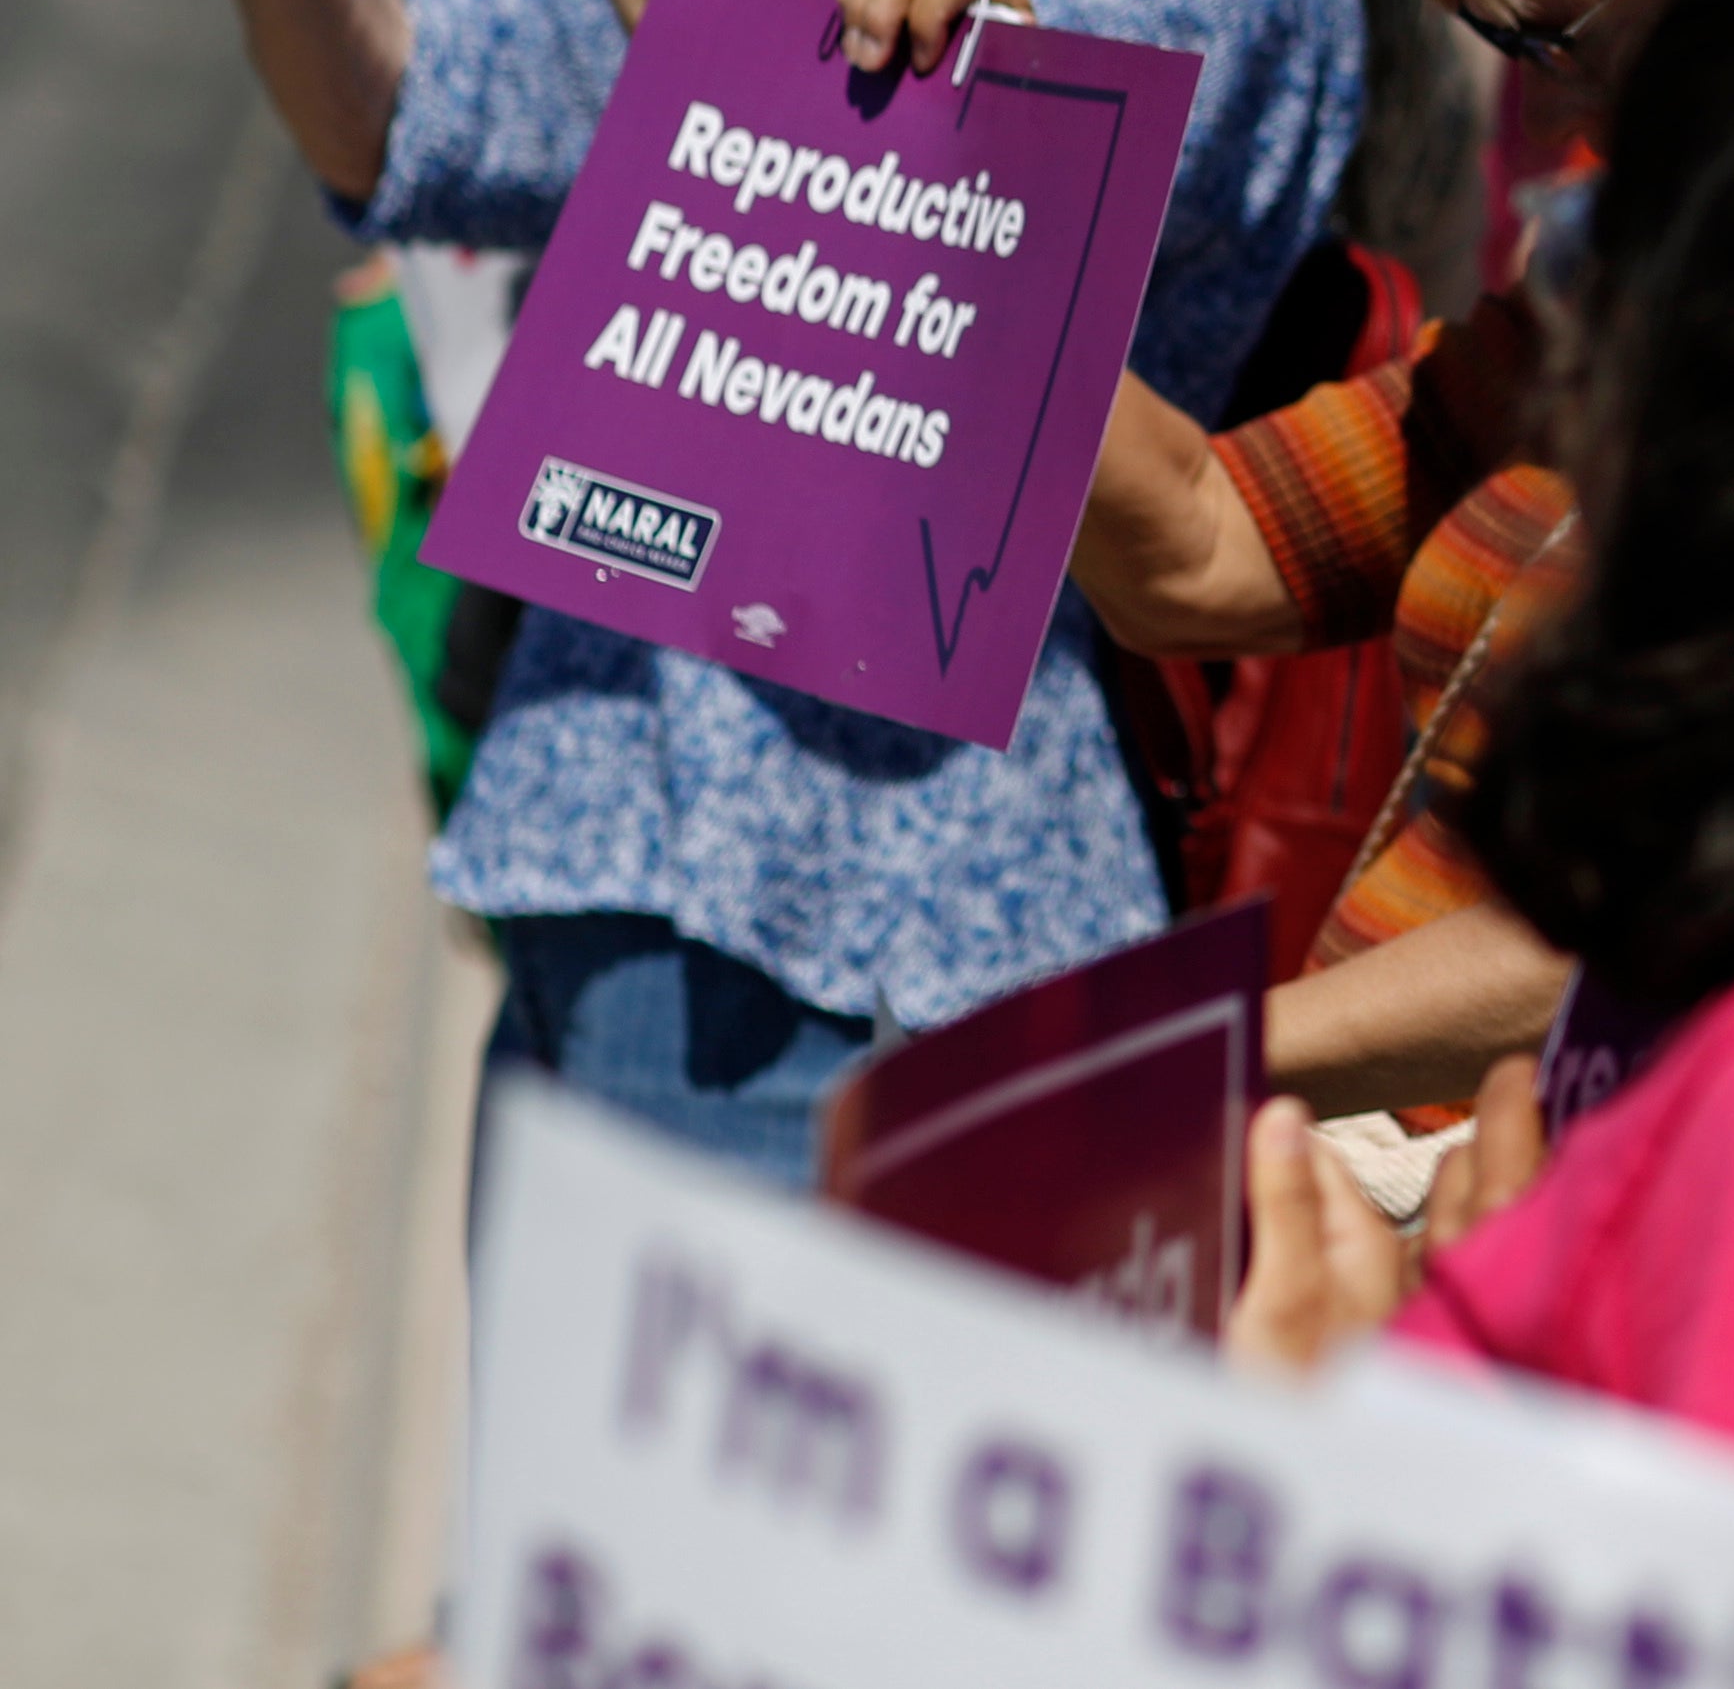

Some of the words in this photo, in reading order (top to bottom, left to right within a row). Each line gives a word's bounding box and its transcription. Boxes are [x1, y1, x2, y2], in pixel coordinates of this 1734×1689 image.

[667, 101, 1026, 259] Reproductive
[626, 201, 892, 339] Freedom
[895, 272, 977, 360] for
[583, 303, 687, 389] All
[678, 329, 952, 469] Nevadans
[582, 486, 699, 559] NARAL
